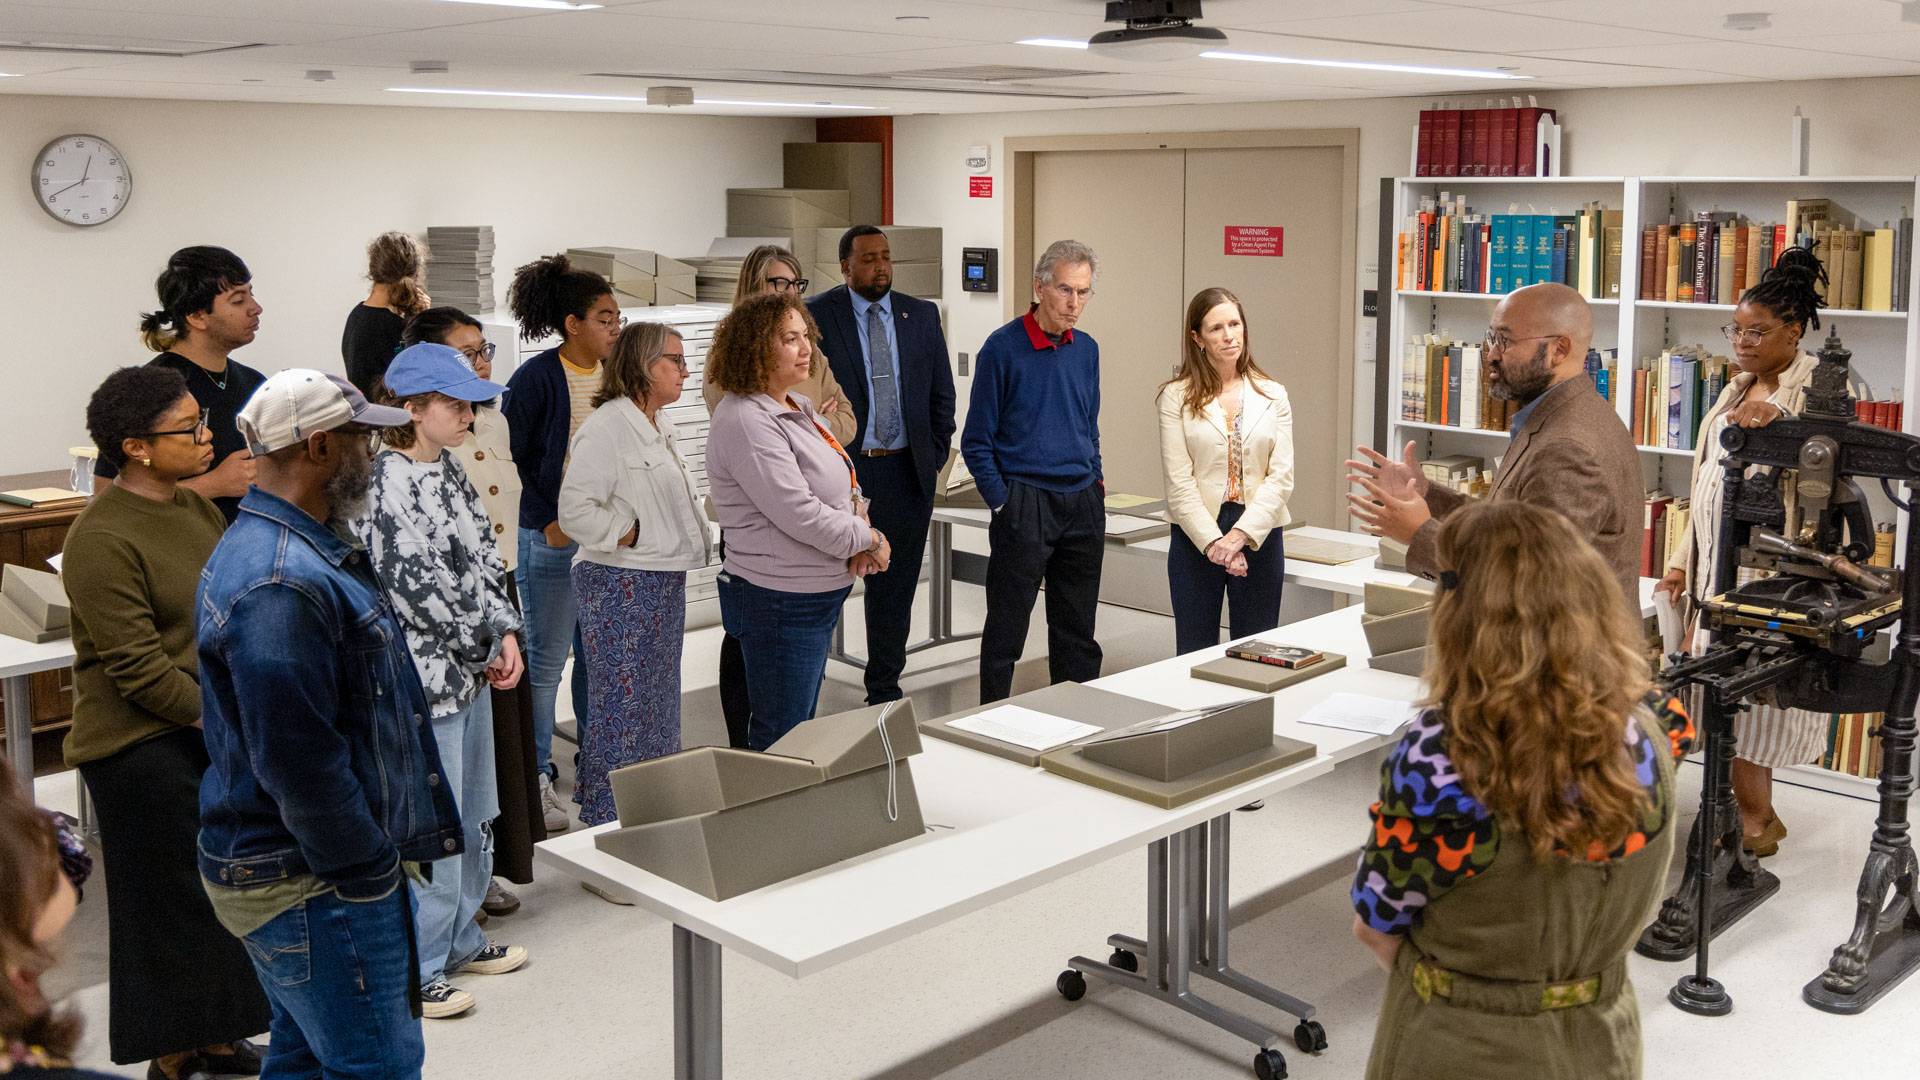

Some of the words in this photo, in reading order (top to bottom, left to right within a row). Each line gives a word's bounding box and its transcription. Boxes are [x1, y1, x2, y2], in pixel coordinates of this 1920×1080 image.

[109, 158, 117, 166] 2
[41, 178, 49, 186] 9
[116, 175, 123, 183] 3
[49, 195, 57, 203] 8
[63, 208, 71, 216] 7
[100, 207, 108, 215] 5
[82, 212, 90, 220] 6
[1239, 228, 1269, 236] WARNING
[1699, 226, 1707, 239] The
[1698, 241, 1706, 250] Art
[1697, 251, 1705, 259] of
[1697, 260, 1705, 271] the
[1696, 272, 1704, 288] Print
